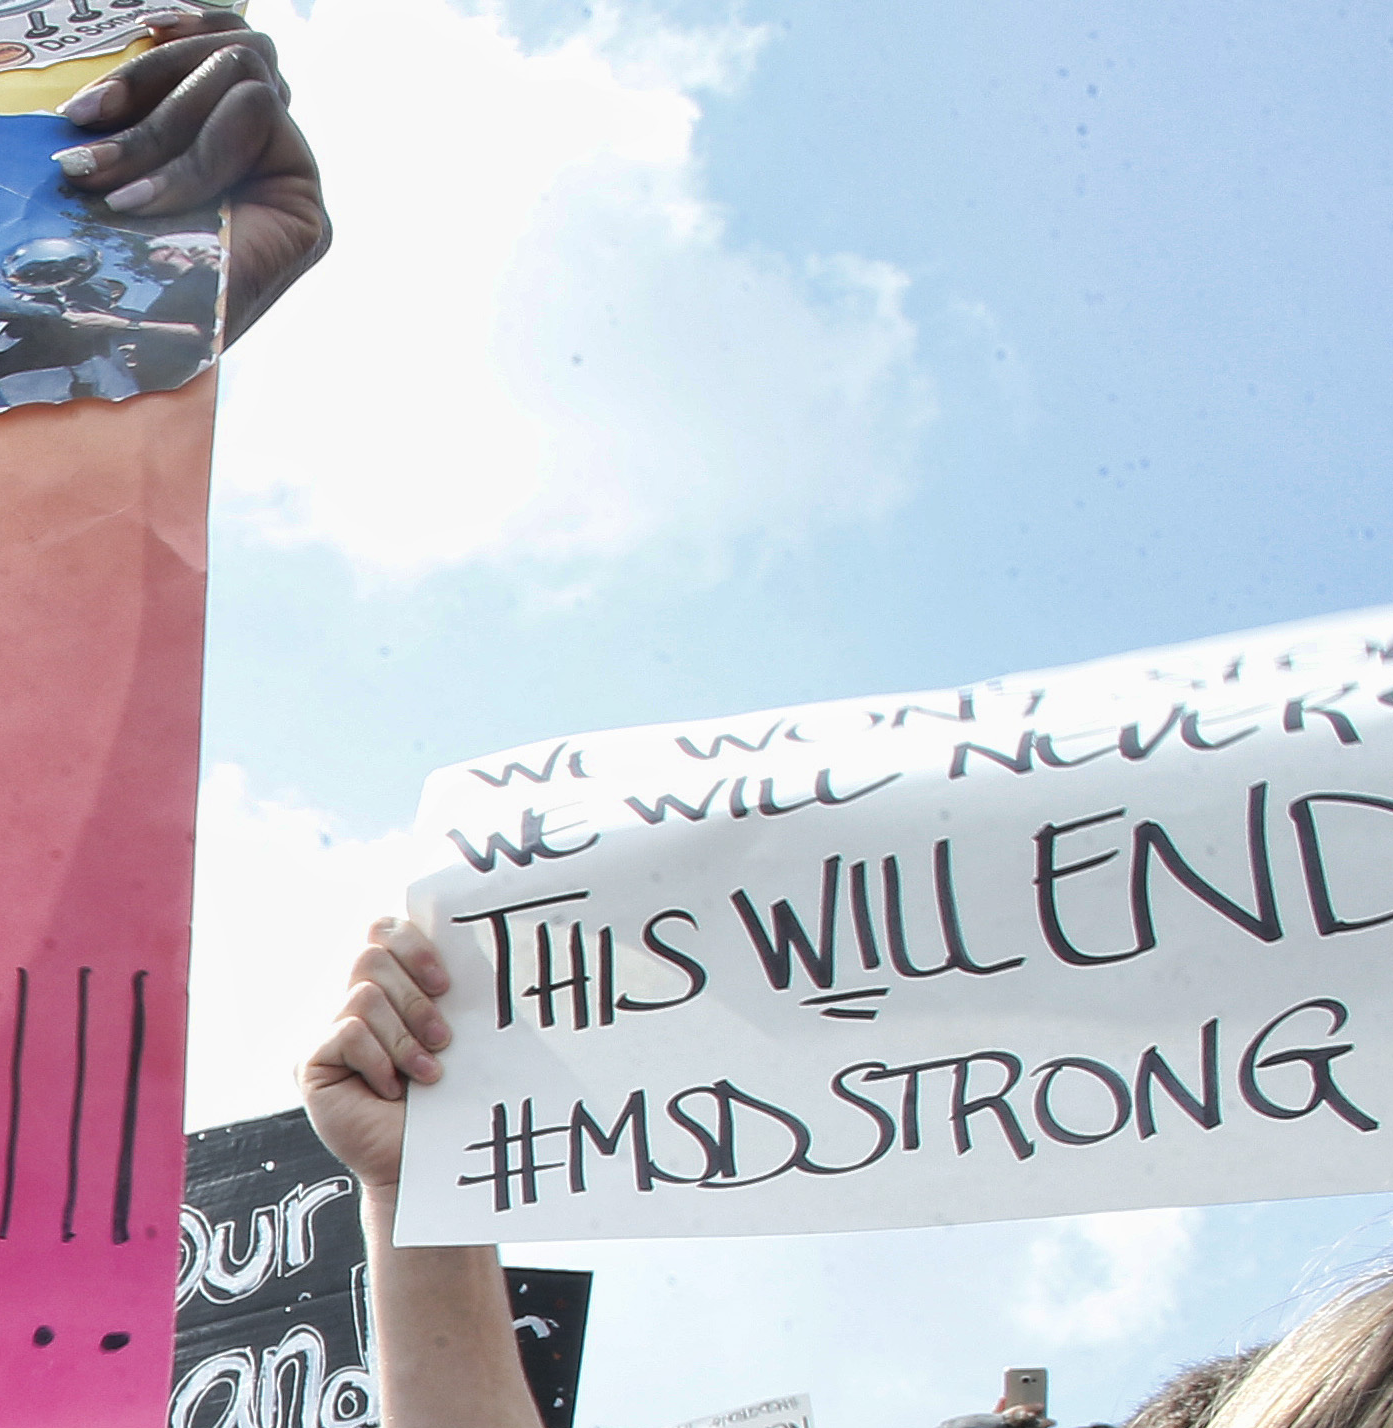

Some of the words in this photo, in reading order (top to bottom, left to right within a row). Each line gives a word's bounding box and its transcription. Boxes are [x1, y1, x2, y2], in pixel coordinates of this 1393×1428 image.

[35, 34, 81, 51] Do
[445, 801, 601, 873] WE
[622, 768, 904, 826] WILL
[947, 681, 1363, 779] NEVER
[449, 890, 710, 1031] THIS
[730, 837, 1028, 995] WILL
[455, 997, 1381, 1214] #MSDSTRONG
